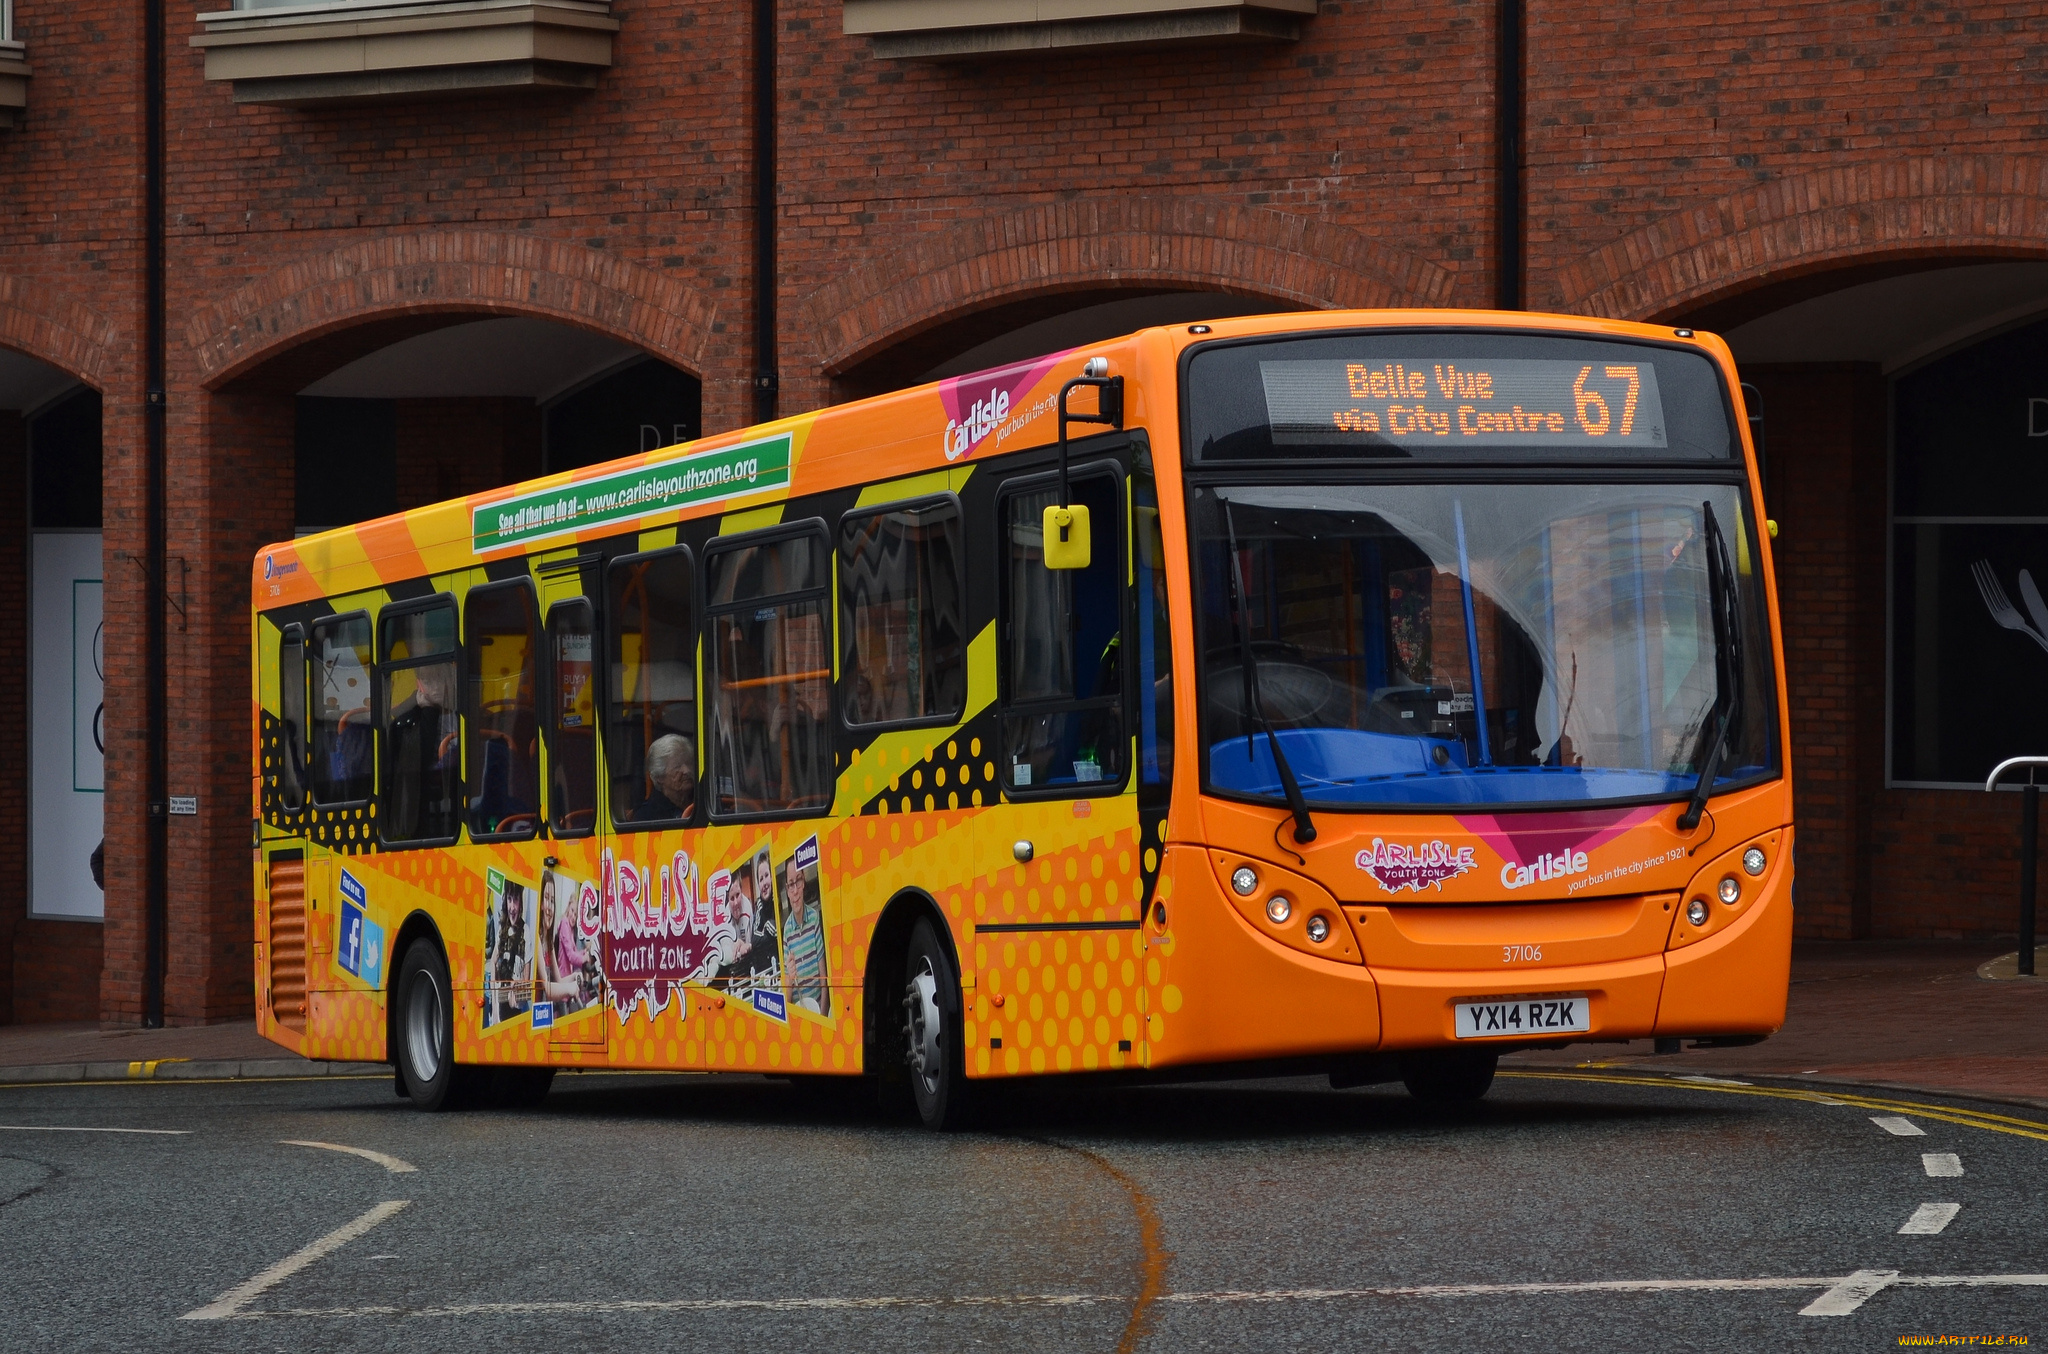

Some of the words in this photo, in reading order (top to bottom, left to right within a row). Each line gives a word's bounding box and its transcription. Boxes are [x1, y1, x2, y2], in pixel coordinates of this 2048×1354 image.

[1346, 364, 1427, 399] Belle
[1434, 364, 1494, 399] Vue
[1573, 366, 1640, 436] 67
[944, 387, 1009, 461] Carlisle
[996, 423, 1011, 449] your
[1012, 414, 1025, 434] bus
[1025, 408, 1032, 424] in
[1032, 400, 1045, 420] the
[1044, 392, 1058, 412] city
[1333, 408, 1380, 432] via
[1387, 404, 1450, 436] City
[1457, 404, 1565, 436] Centre
[498, 513, 513, 537] See
[514, 508, 525, 533] all
[525, 505, 542, 529] that
[543, 501, 555, 526] we
[556, 498, 567, 523] do
[567, 496, 577, 519] at
[586, 458, 757, 516] www.carlisleyouthzone.org
[564, 675, 581, 685] BUY
[797, 844, 816, 864] Cooking
[1356, 839, 1474, 868] CARLISLE
[1501, 848, 1588, 889] Carlisle
[1385, 868, 1418, 879] YOUTH
[1421, 869, 1446, 878] ZONE
[1568, 879, 1588, 895] your
[1589, 874, 1604, 887] bus
[1605, 870, 1613, 881] in
[1613, 866, 1628, 878] the
[1628, 859, 1644, 874] city
[1644, 855, 1665, 869] since
[1666, 846, 1686, 862] 1921
[578, 849, 731, 938] CARLISLE
[613, 943, 656, 973] YOUTH
[659, 947, 692, 971] ZONE
[1503, 945, 1542, 963] 37106
[758, 993, 767, 1008] Fun
[767, 997, 782, 1016] Games
[1470, 1005, 1522, 1031] YX14
[1529, 1001, 1574, 1028] RZK
